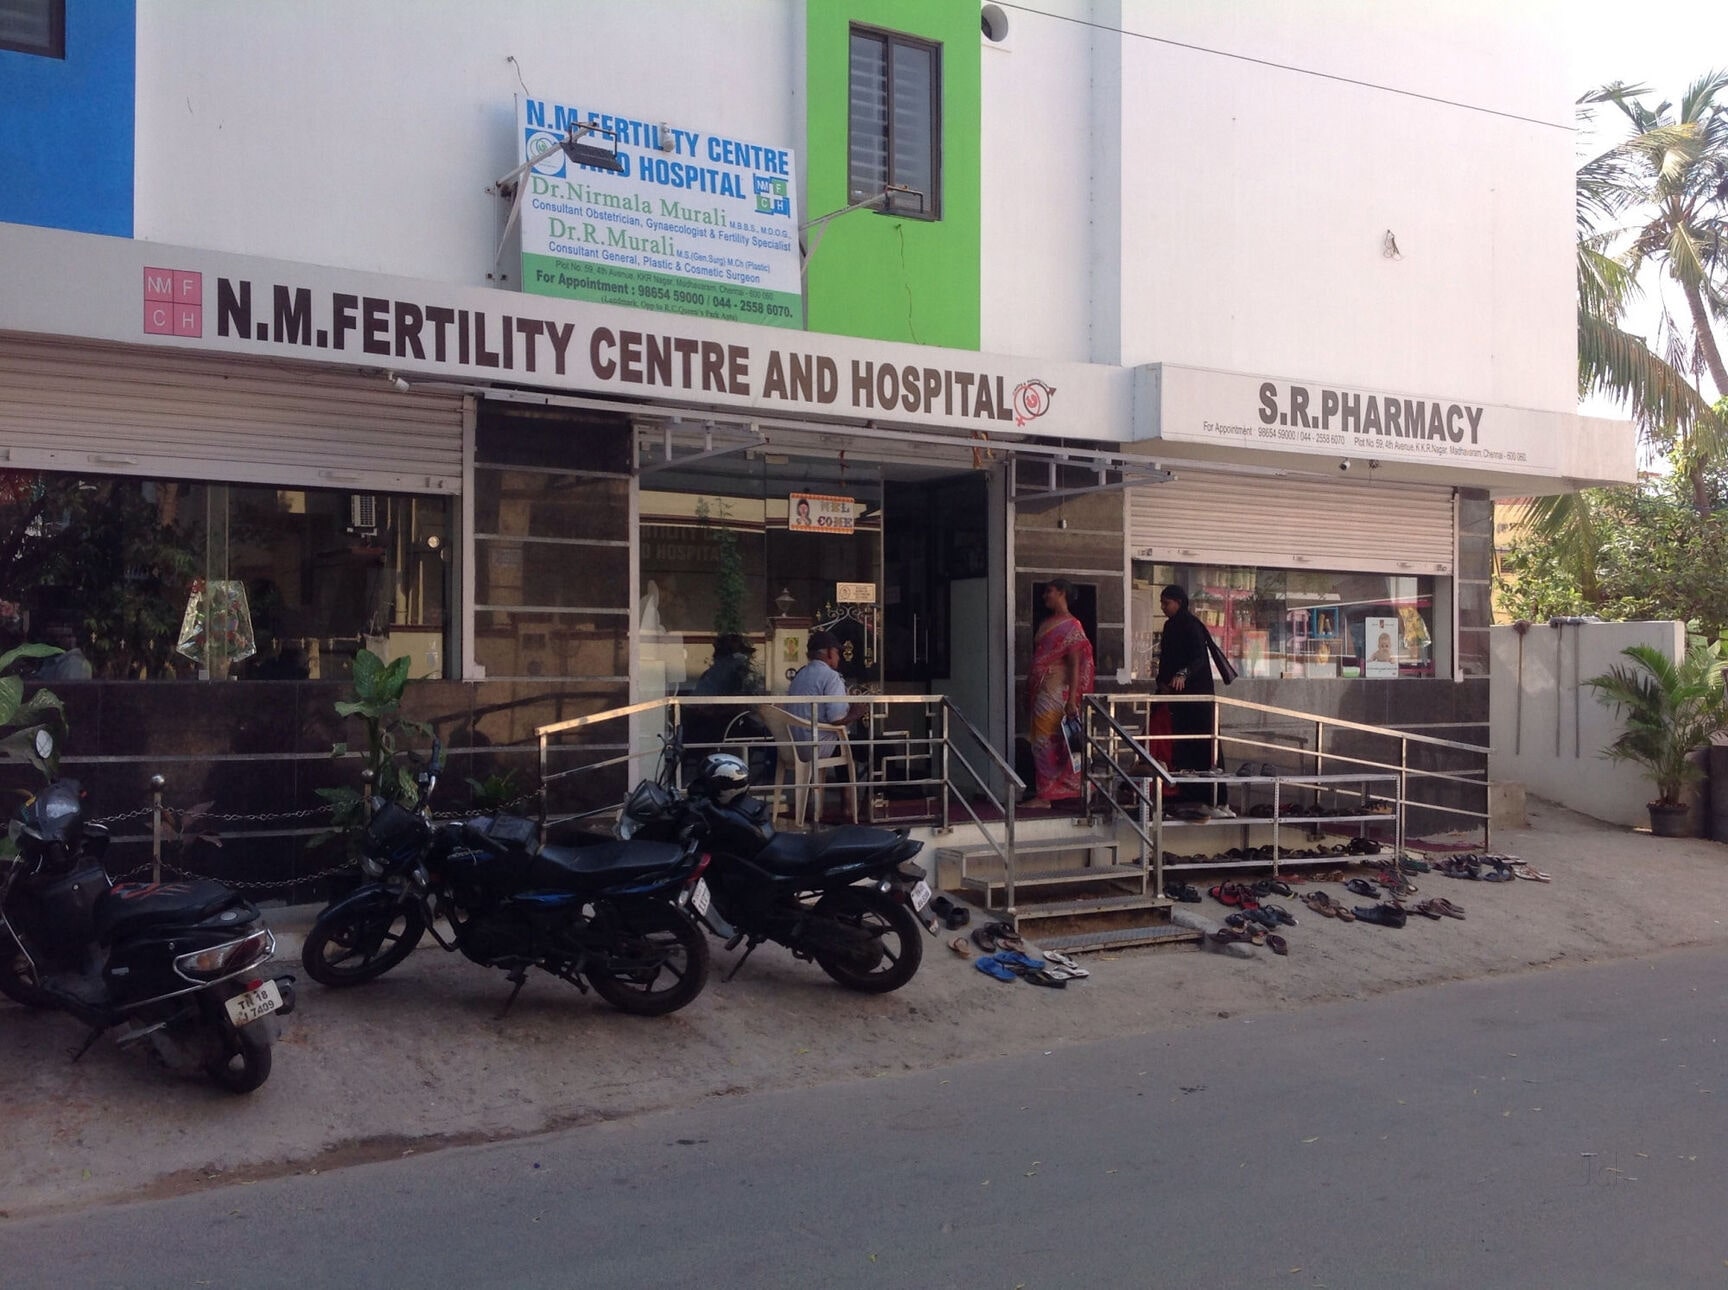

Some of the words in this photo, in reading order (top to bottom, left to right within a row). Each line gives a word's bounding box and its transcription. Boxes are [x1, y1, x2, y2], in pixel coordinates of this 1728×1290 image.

[526, 99, 699, 157] N.MFERTILTY
[707, 136, 789, 175] CENTRE
[640, 156, 746, 199] HOSPITAL
[531, 176, 653, 214] Dr.Nirmala
[660, 199, 727, 227] Murali
[777, 200, 784, 211] H
[532, 198, 583, 217] Consultant
[586, 208, 643, 228] Obstetrician,
[646, 218, 707, 240] Gynaecologist
[709, 230, 716, 239] &
[718, 231, 750, 249] Fertility
[752, 235, 791, 252] Specialist
[549, 217, 675, 257] Dr.R.Murali
[549, 240, 600, 261] Consultant
[602, 249, 639, 268] General,
[643, 255, 673, 271] Plastic
[676, 262, 683, 272] &
[684, 262, 724, 279] Cosmetic
[726, 267, 760, 285] Surgeon
[148, 275, 172, 295] NM
[183, 279, 193, 296] F
[536, 269, 555, 283] For
[558, 273, 629, 297] Appointment
[637, 285, 671, 302] 98654
[673, 290, 704, 306] 59000
[712, 296, 732, 310] 044
[740, 300, 764, 315] 2558
[766, 303, 793, 318] 6070.
[152, 310, 166, 327] C
[182, 313, 194, 329] H
[217, 277, 575, 375] N.M.FERTILITY
[590, 327, 750, 397] CENTRE
[763, 350, 838, 405] AND
[851, 359, 1014, 421] HOSPITAL
[1203, 420, 1213, 432] For
[1215, 423, 1252, 437] Appointment
[1258, 427, 1276, 439] 98654
[1278, 429, 1295, 441] 59000
[1300, 431, 1311, 441] 044
[1315, 432, 1329, 444] 2558
[1330, 434, 1345, 445] 6070
[1354, 436, 1365, 448] Plot
[1258, 382, 1484, 445] S.R.PHARMACY
[250, 1000, 275, 1018] 7409
[255, 990, 268, 1002] 18
